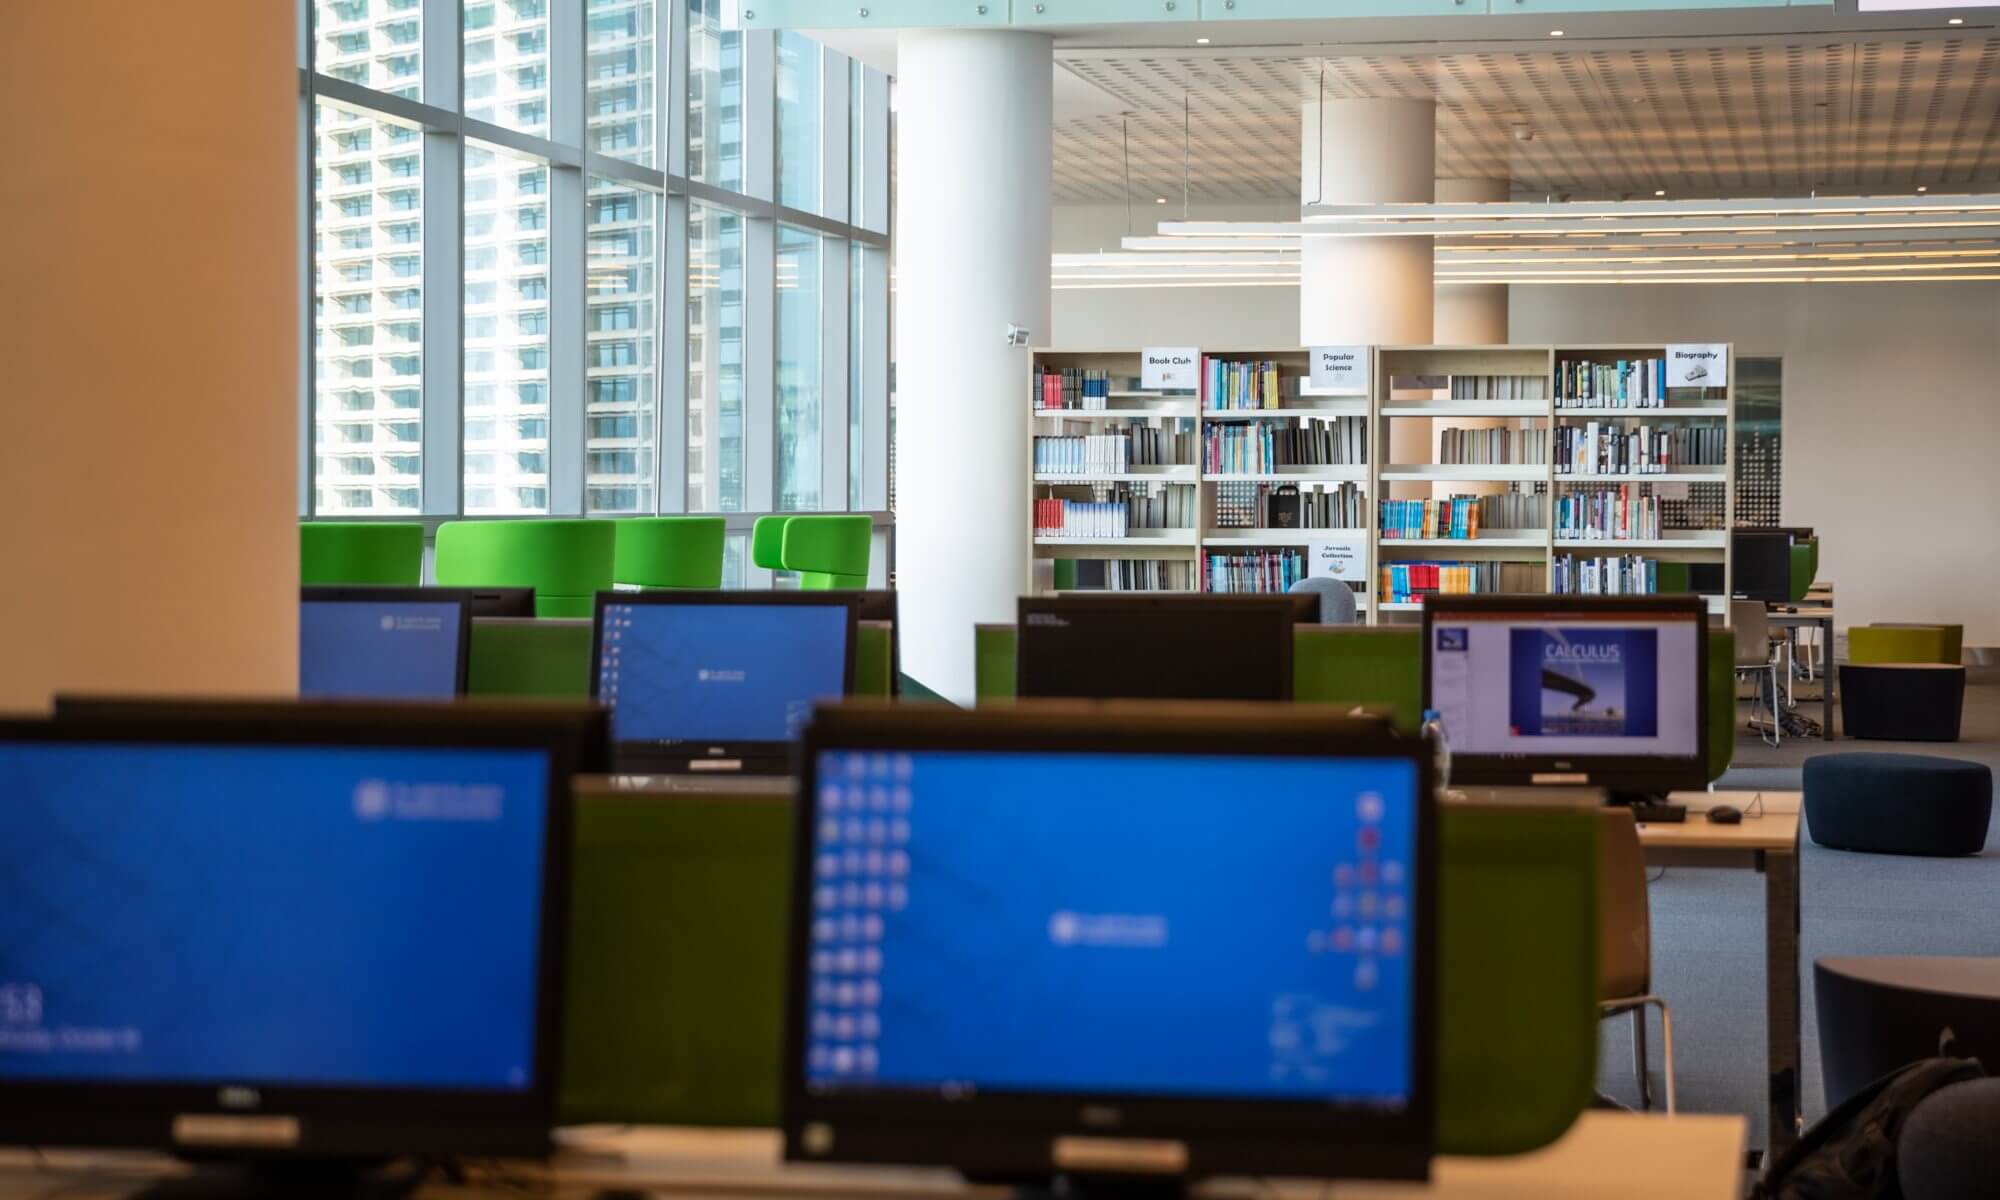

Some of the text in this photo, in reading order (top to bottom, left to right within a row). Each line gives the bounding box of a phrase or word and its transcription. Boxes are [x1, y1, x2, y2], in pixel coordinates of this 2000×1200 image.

[1323, 353, 1354, 362] Popular
[1675, 351, 1718, 360] Biography
[1149, 356, 1191, 365] Book Club
[1325, 363, 1352, 371] Science
[1545, 643, 1620, 657] CALCULUS
